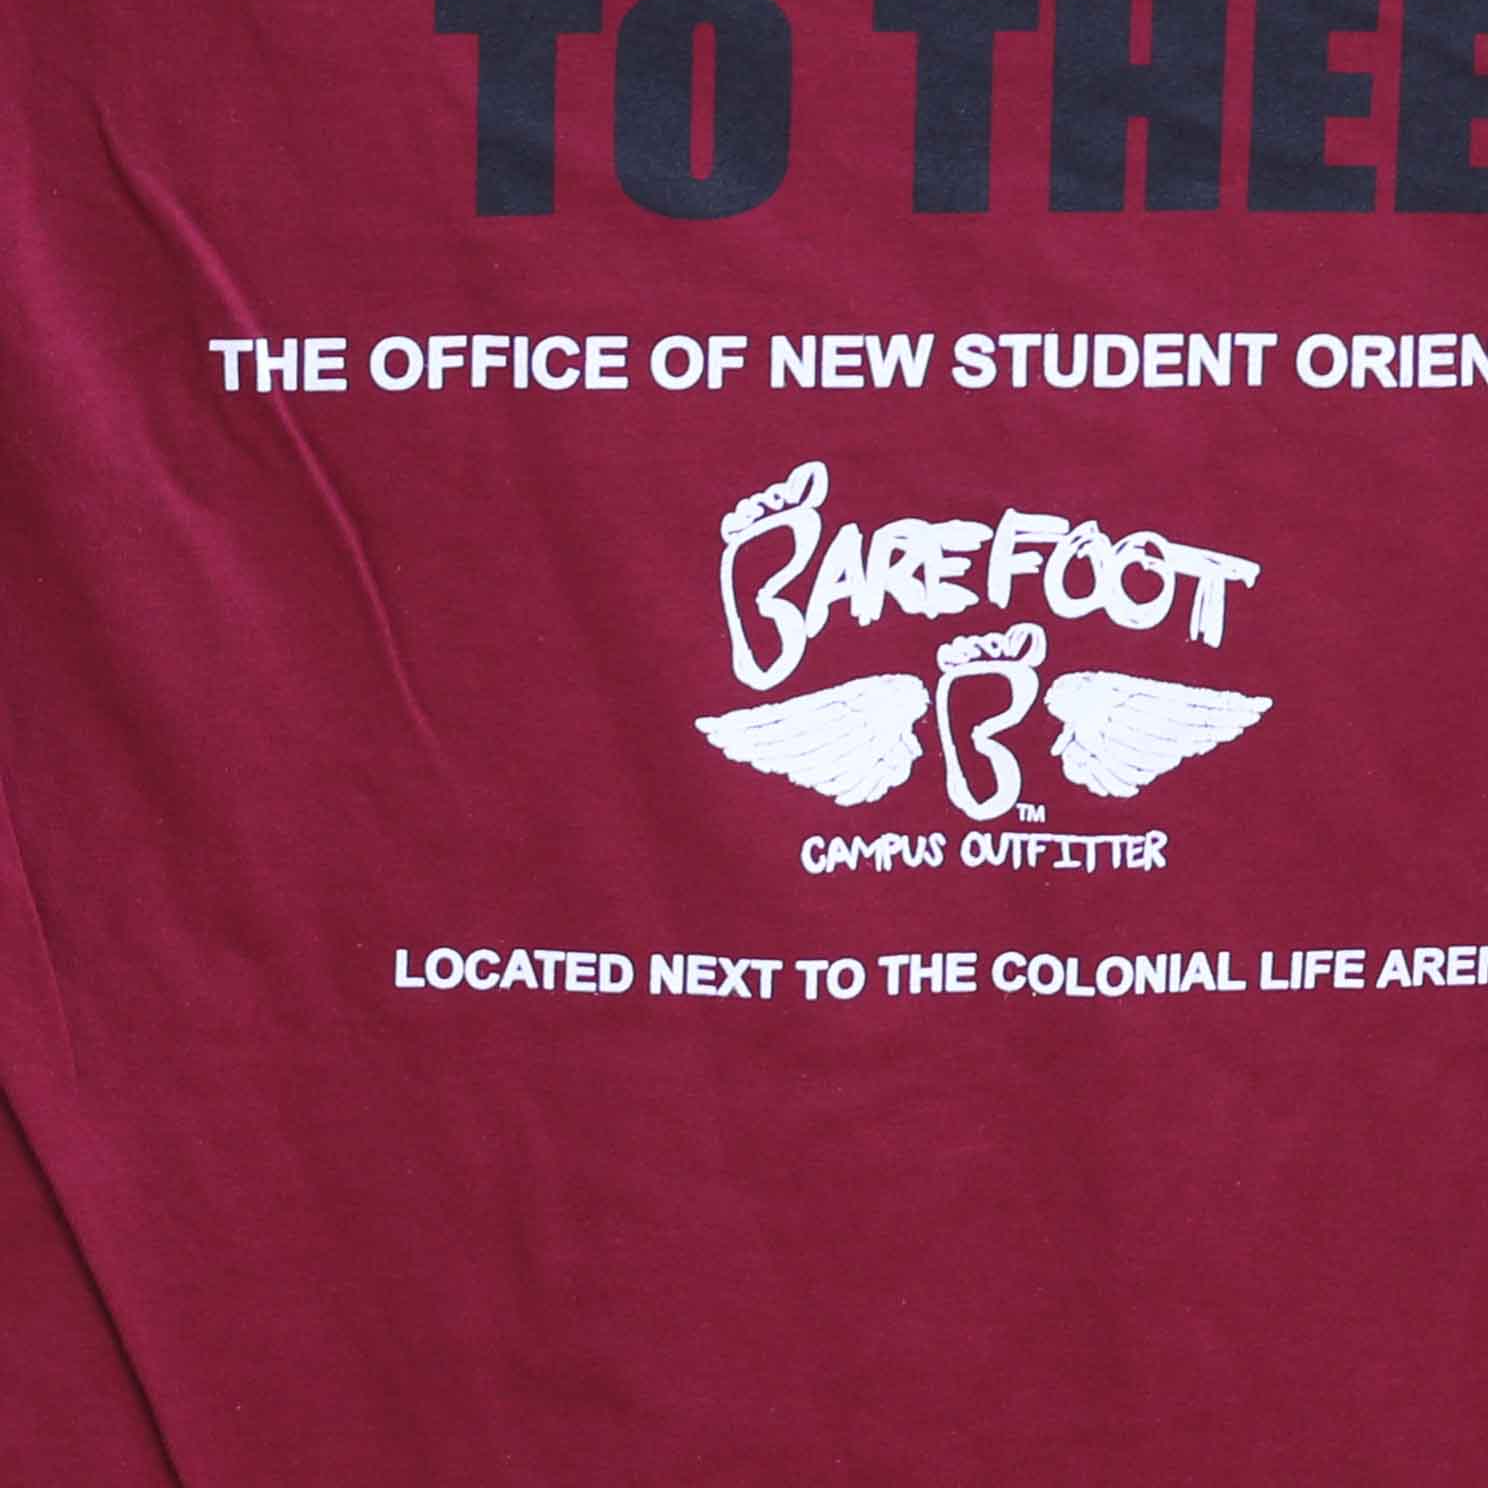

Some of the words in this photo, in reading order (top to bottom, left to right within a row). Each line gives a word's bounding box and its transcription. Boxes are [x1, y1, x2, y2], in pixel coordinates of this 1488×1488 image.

[208, 337, 348, 392] THE
[368, 334, 629, 391] OFFICE
[650, 335, 748, 390] OF
[770, 333, 935, 389] NEW
[951, 332, 1278, 389] STUDENT
[720, 460, 1262, 690] BAREFOOT
[800, 832, 947, 874] CAMPUS
[960, 829, 1168, 873] OUTFITTER
[394, 947, 634, 993] LOCATED
[648, 953, 784, 999] NEXT
[795, 958, 866, 1001] TO
[877, 952, 978, 996] THE
[991, 951, 1247, 997] COLONIAL
[1259, 949, 1366, 991] LIFE
